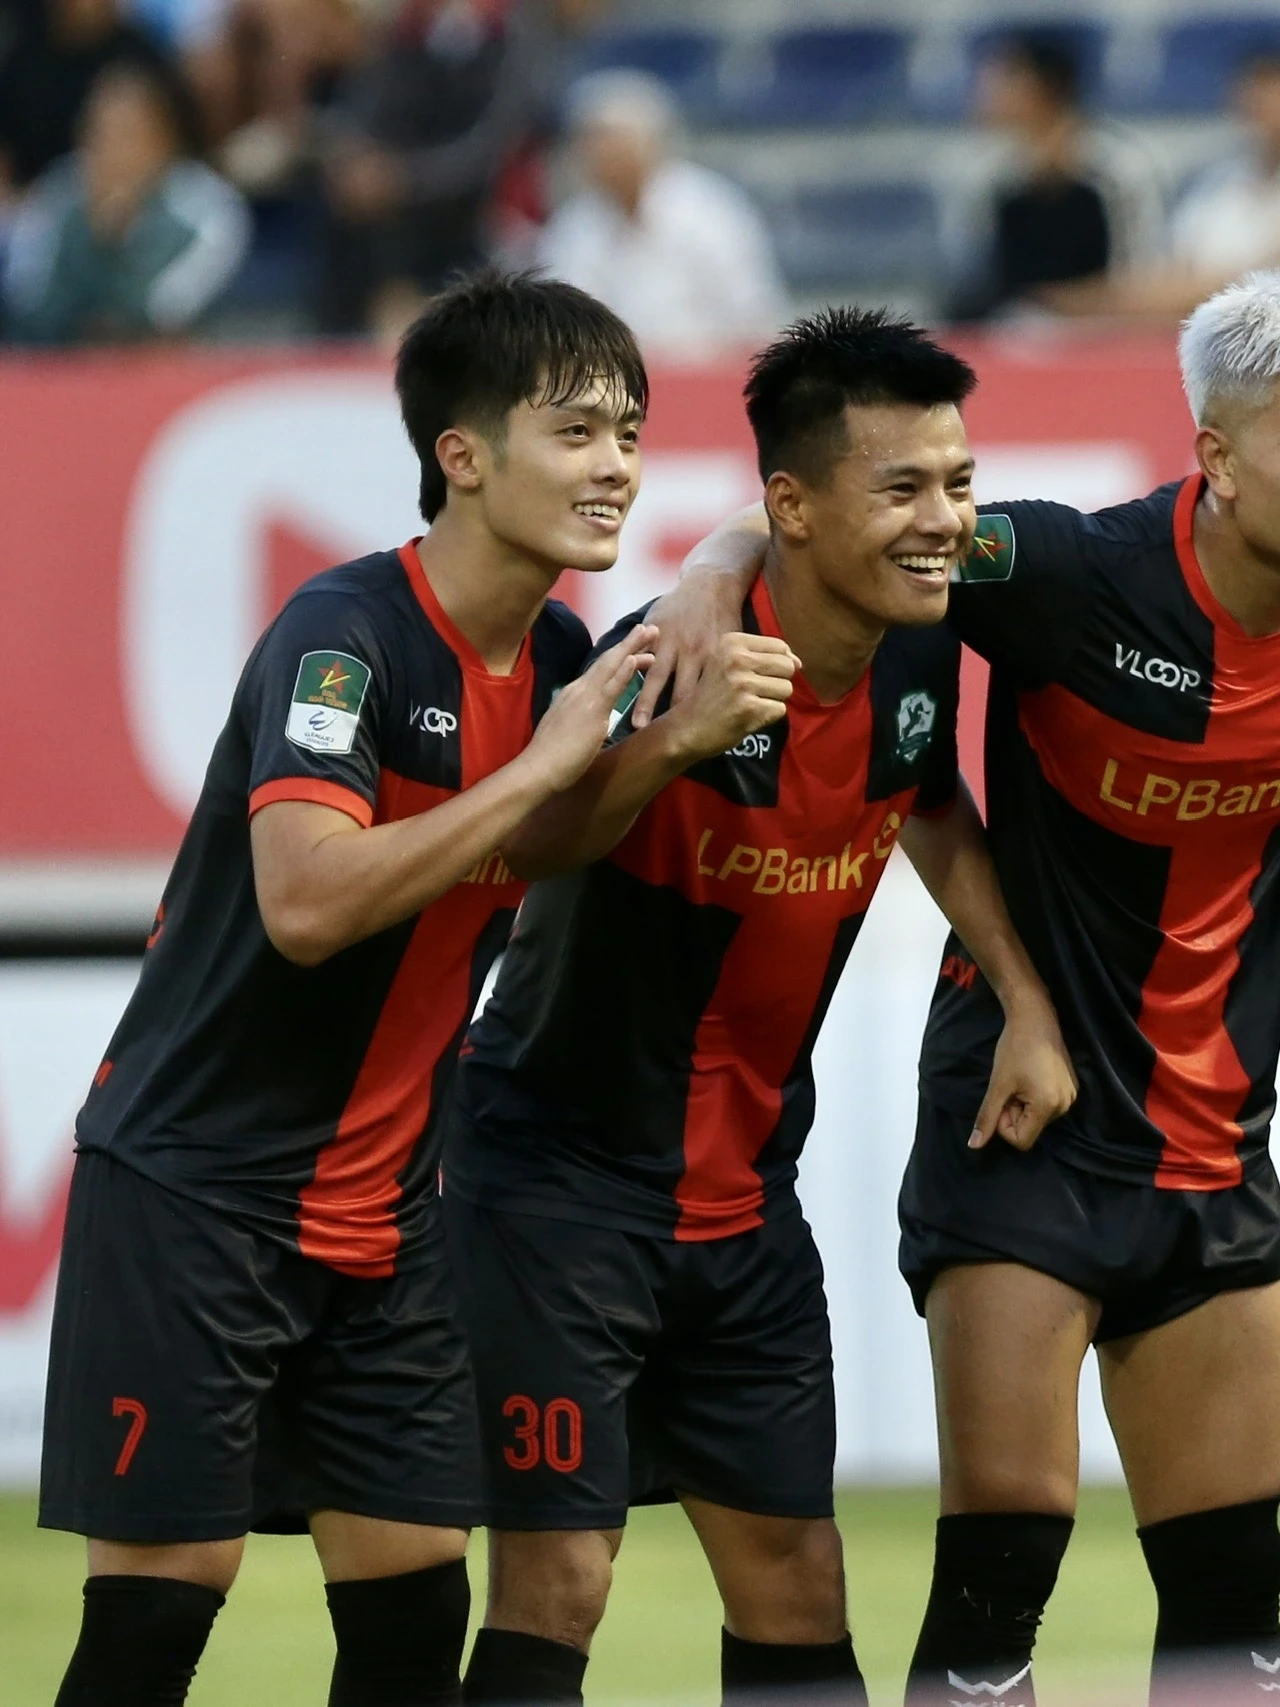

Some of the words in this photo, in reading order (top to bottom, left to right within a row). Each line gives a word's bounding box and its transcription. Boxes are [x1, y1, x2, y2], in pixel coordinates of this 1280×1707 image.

[1114, 642, 1202, 694] VLOOP
[697, 828, 869, 896] LPBank
[112, 1396, 148, 1477] 7
[501, 1393, 585, 1472] 30
